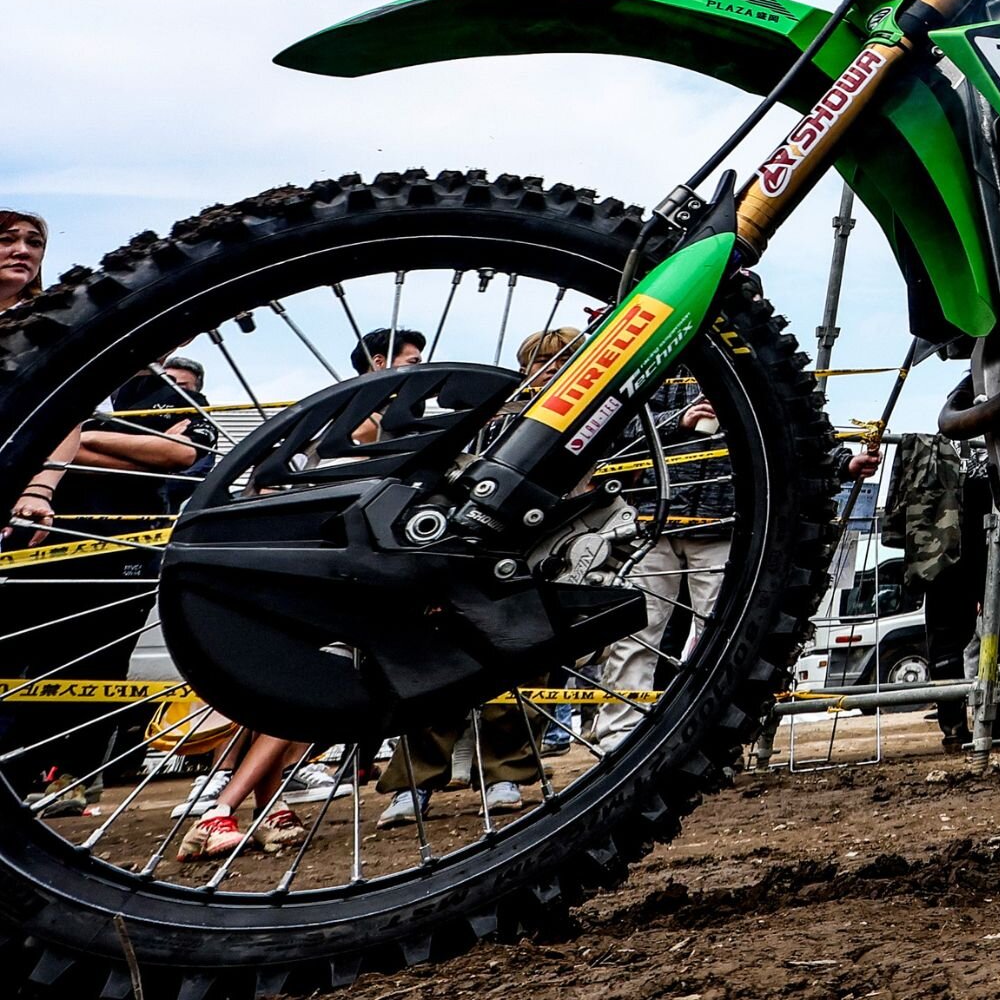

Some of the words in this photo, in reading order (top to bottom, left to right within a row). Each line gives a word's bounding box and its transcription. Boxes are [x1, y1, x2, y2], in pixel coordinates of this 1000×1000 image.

[706, 0, 753, 17] PLAZA
[790, 51, 882, 150] SHOWA
[541, 304, 656, 416] PIRELLI
